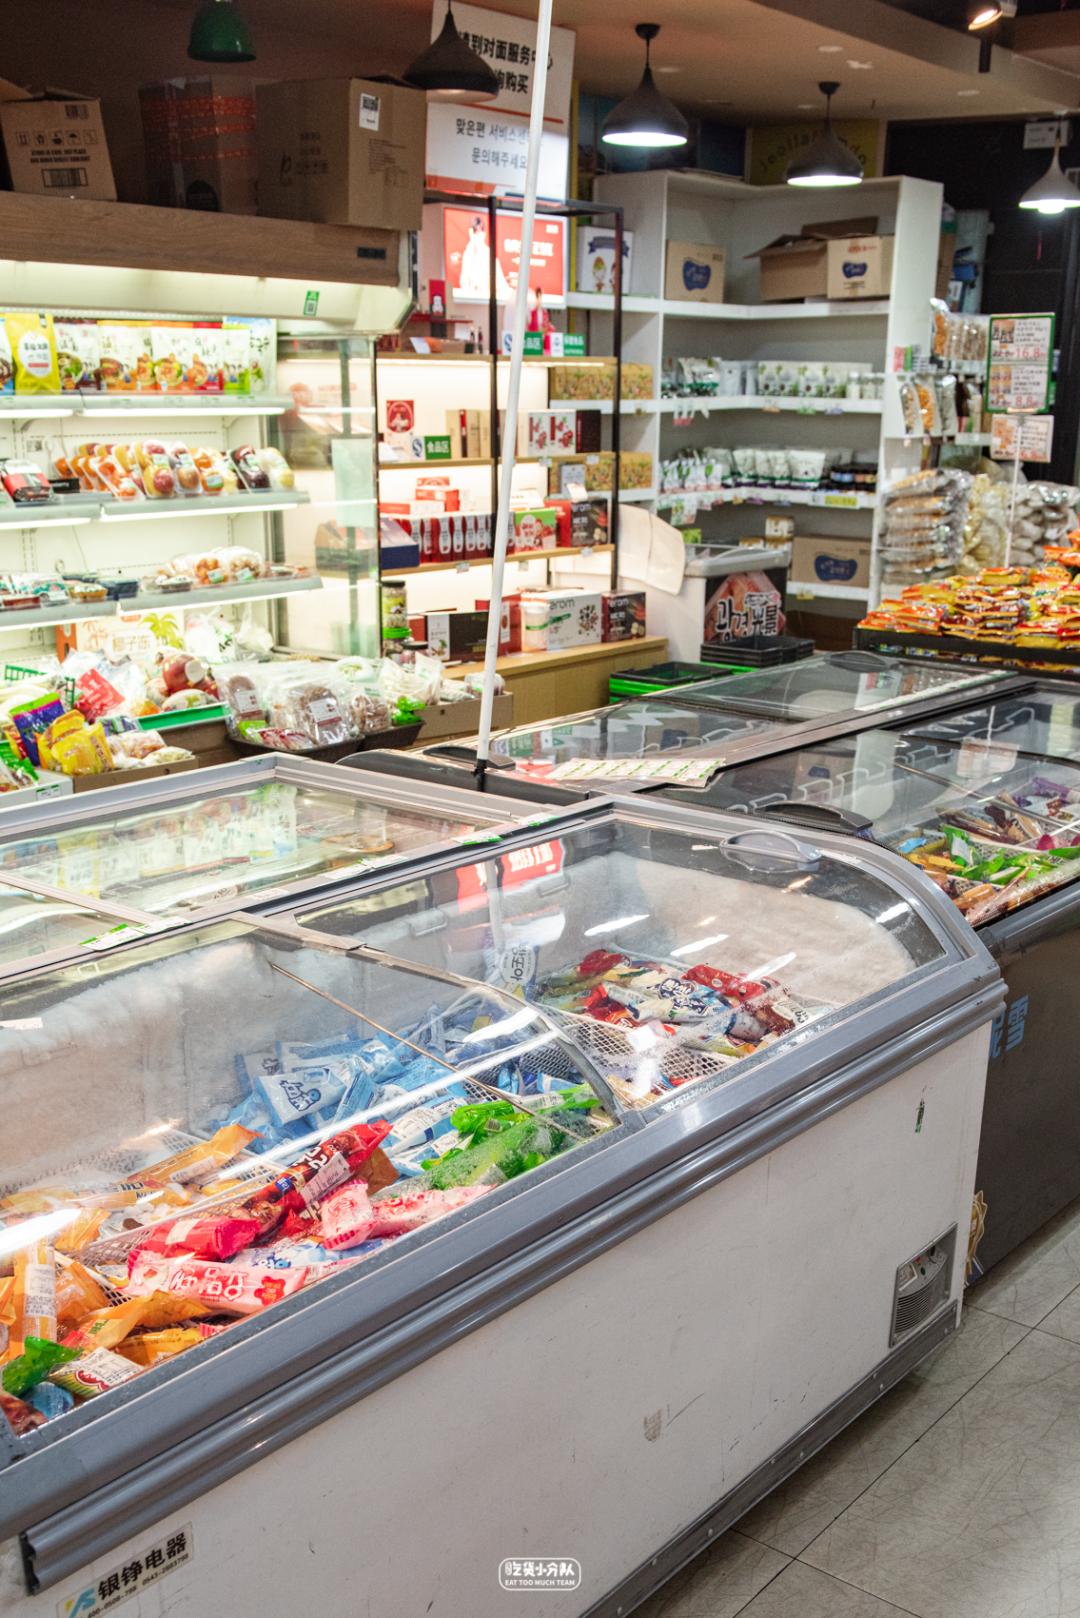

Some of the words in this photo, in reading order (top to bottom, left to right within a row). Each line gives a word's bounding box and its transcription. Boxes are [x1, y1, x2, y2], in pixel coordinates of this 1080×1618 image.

[456, 118, 485, 138] 맞은편
[427, 440, 449, 454] 食品区
[549, 598, 575, 610] erom
[98, 1531, 188, 1600] 银铮电器
